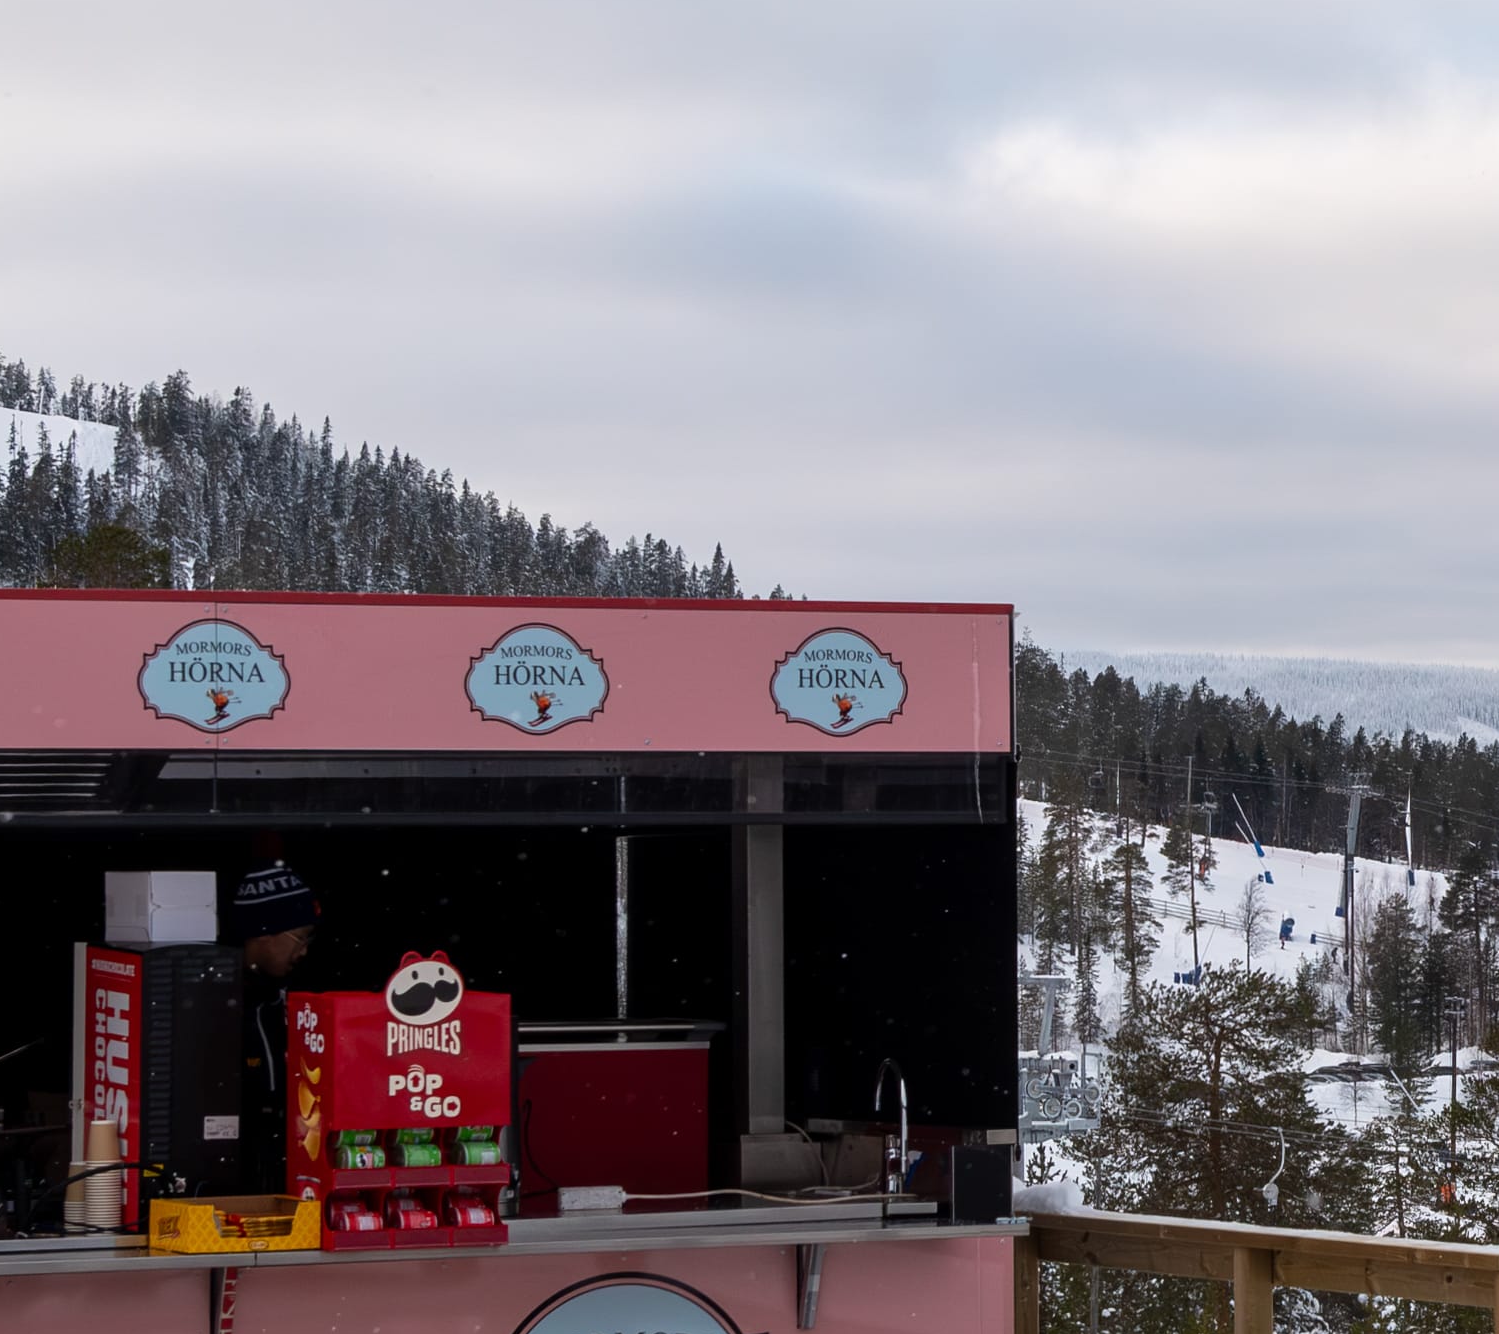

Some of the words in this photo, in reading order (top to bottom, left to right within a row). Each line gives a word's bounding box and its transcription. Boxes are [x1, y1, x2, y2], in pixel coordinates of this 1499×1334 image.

[176, 641, 252, 657] MORMORS
[500, 645, 573, 660] MORMORS
[804, 649, 873, 664] MORMORS
[168, 657, 266, 683] HÖRNA
[494, 660, 586, 686] HÖRNA
[798, 664, 885, 689] HÖRNA
[297, 1004, 318, 1030] POP
[304, 1032, 325, 1054] &GO
[387, 1020, 461, 1057] PRINGLES
[94, 988, 106, 1124] CHOCOL
[388, 1065, 443, 1097] POP
[410, 1095, 461, 1118] &GO
